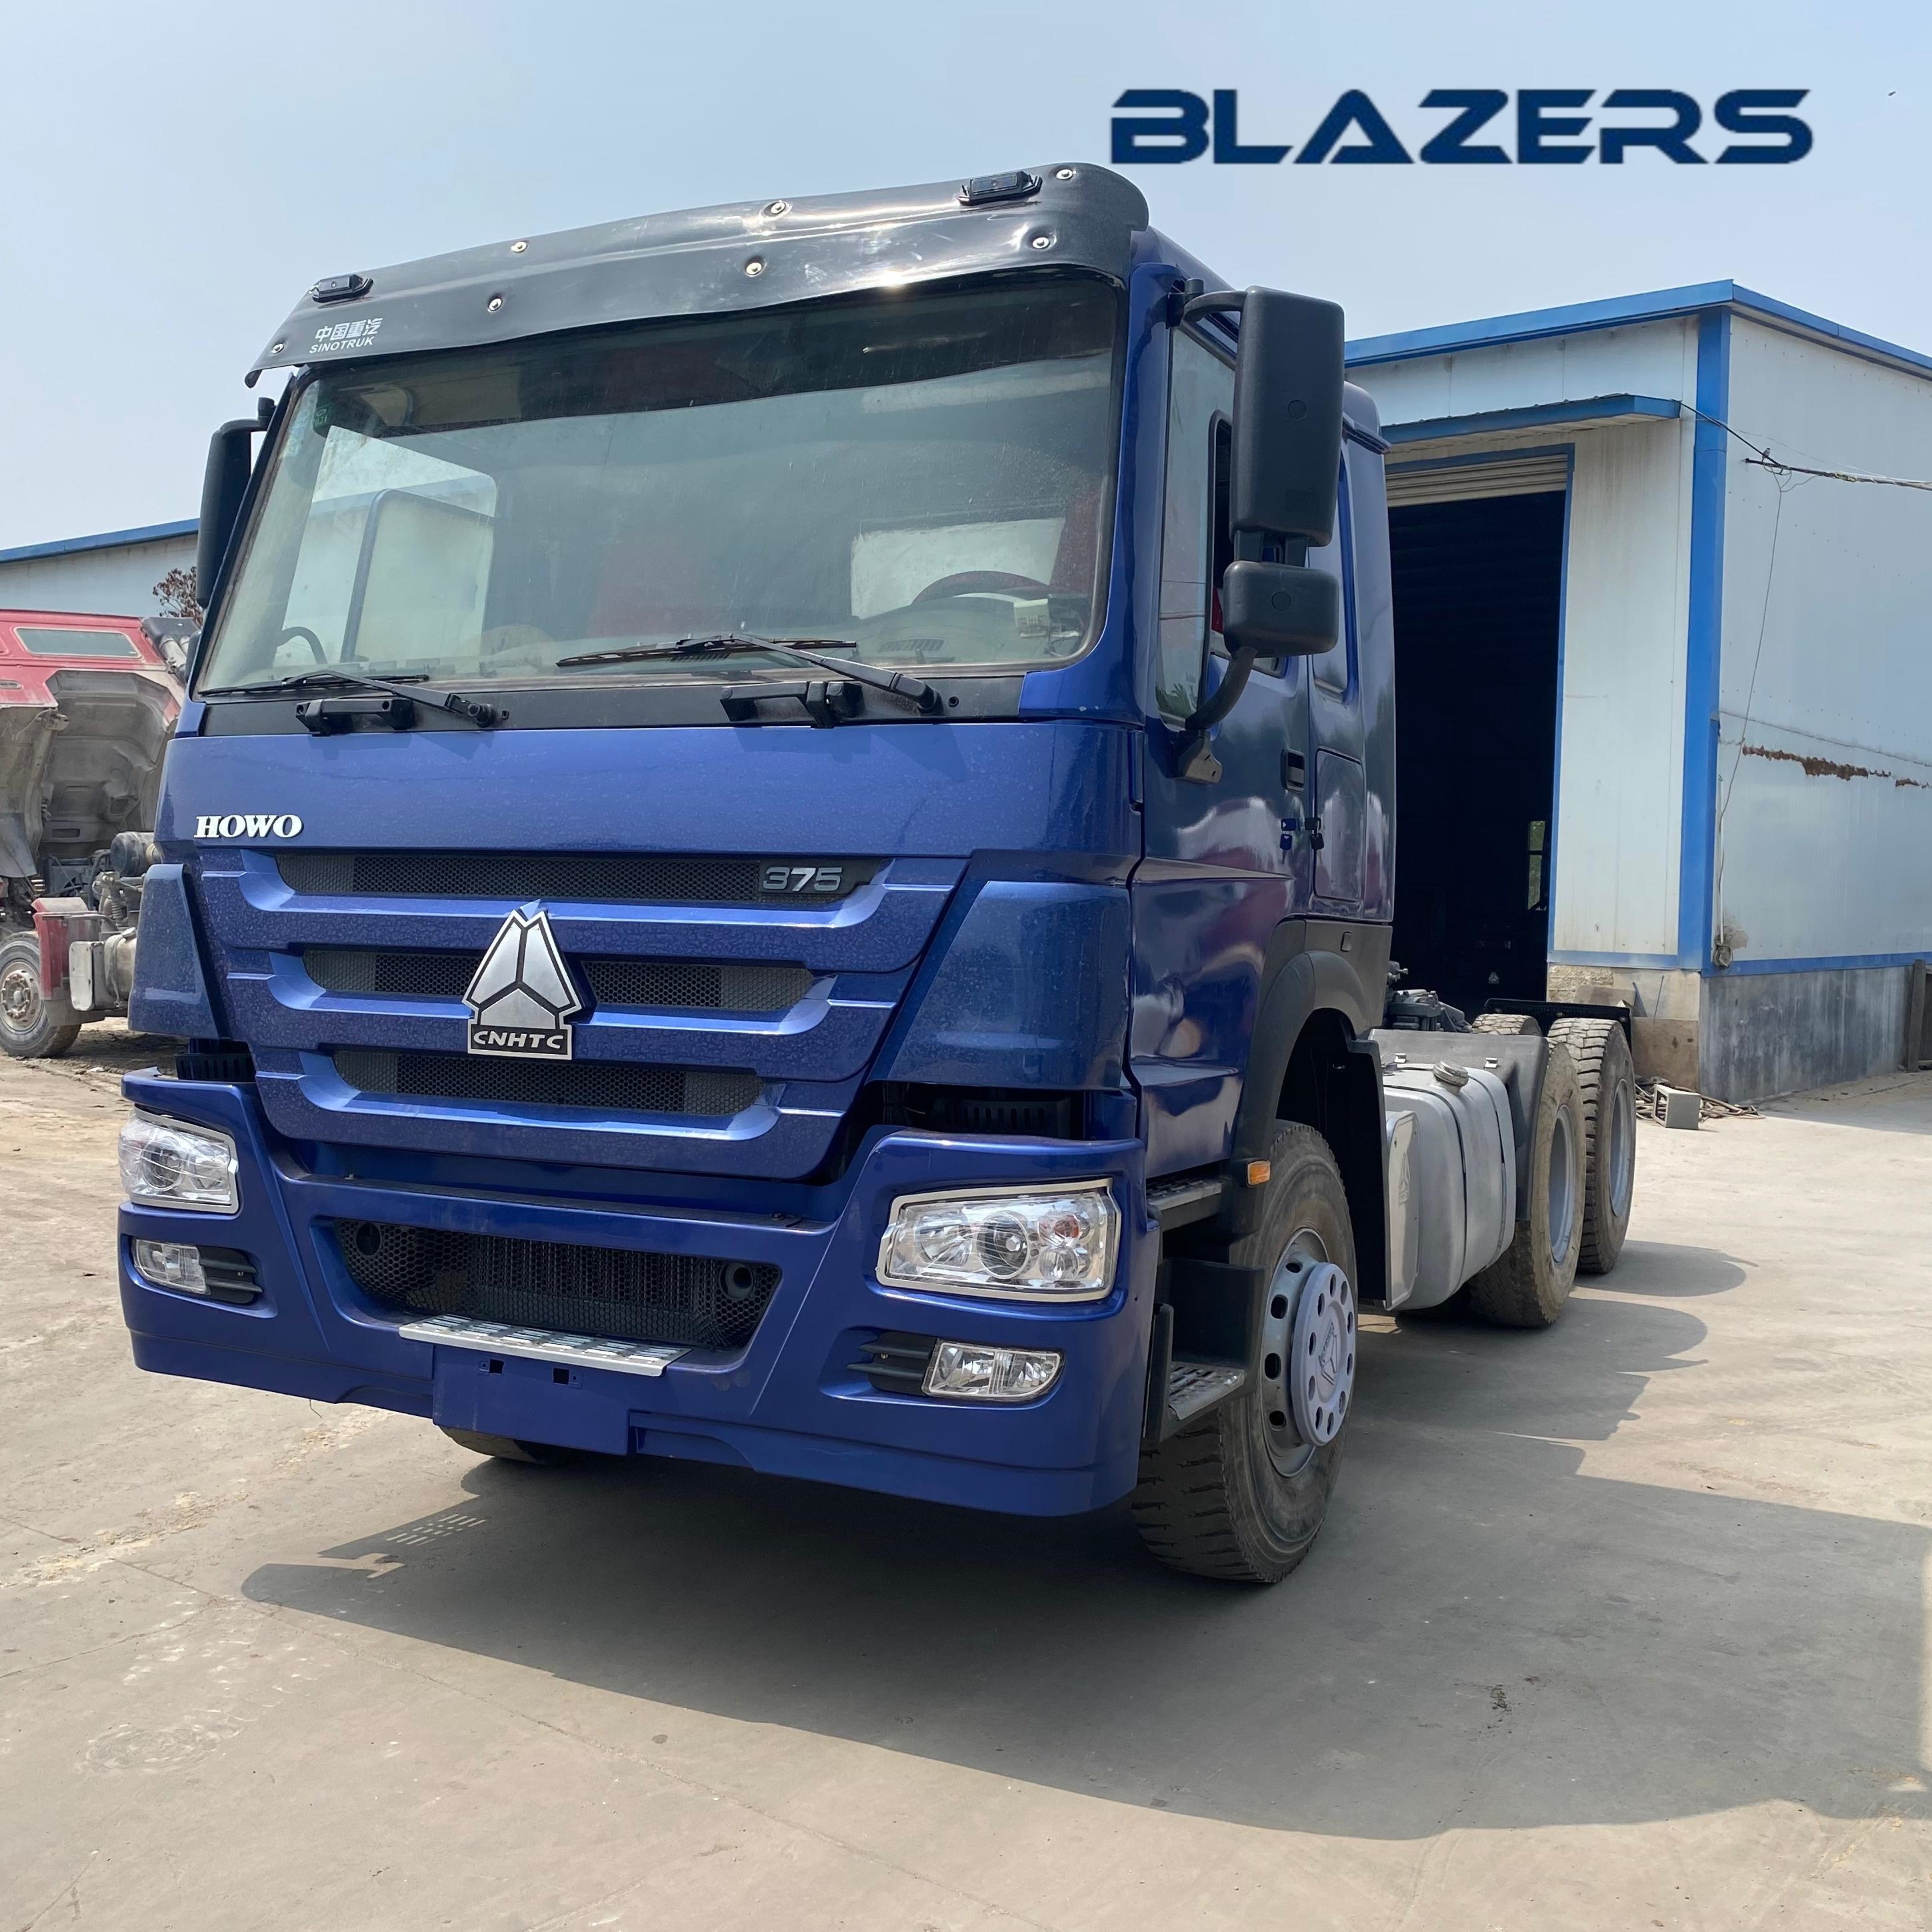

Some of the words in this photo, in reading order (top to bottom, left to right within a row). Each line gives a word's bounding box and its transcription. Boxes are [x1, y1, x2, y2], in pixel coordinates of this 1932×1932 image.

[315, 317, 383, 343] 中国重汽
[309, 336, 375, 354] SINOTRUK
[193, 813, 303, 839] HOWO
[763, 867, 843, 891] 375
[473, 1030, 564, 1050] CNHTC
